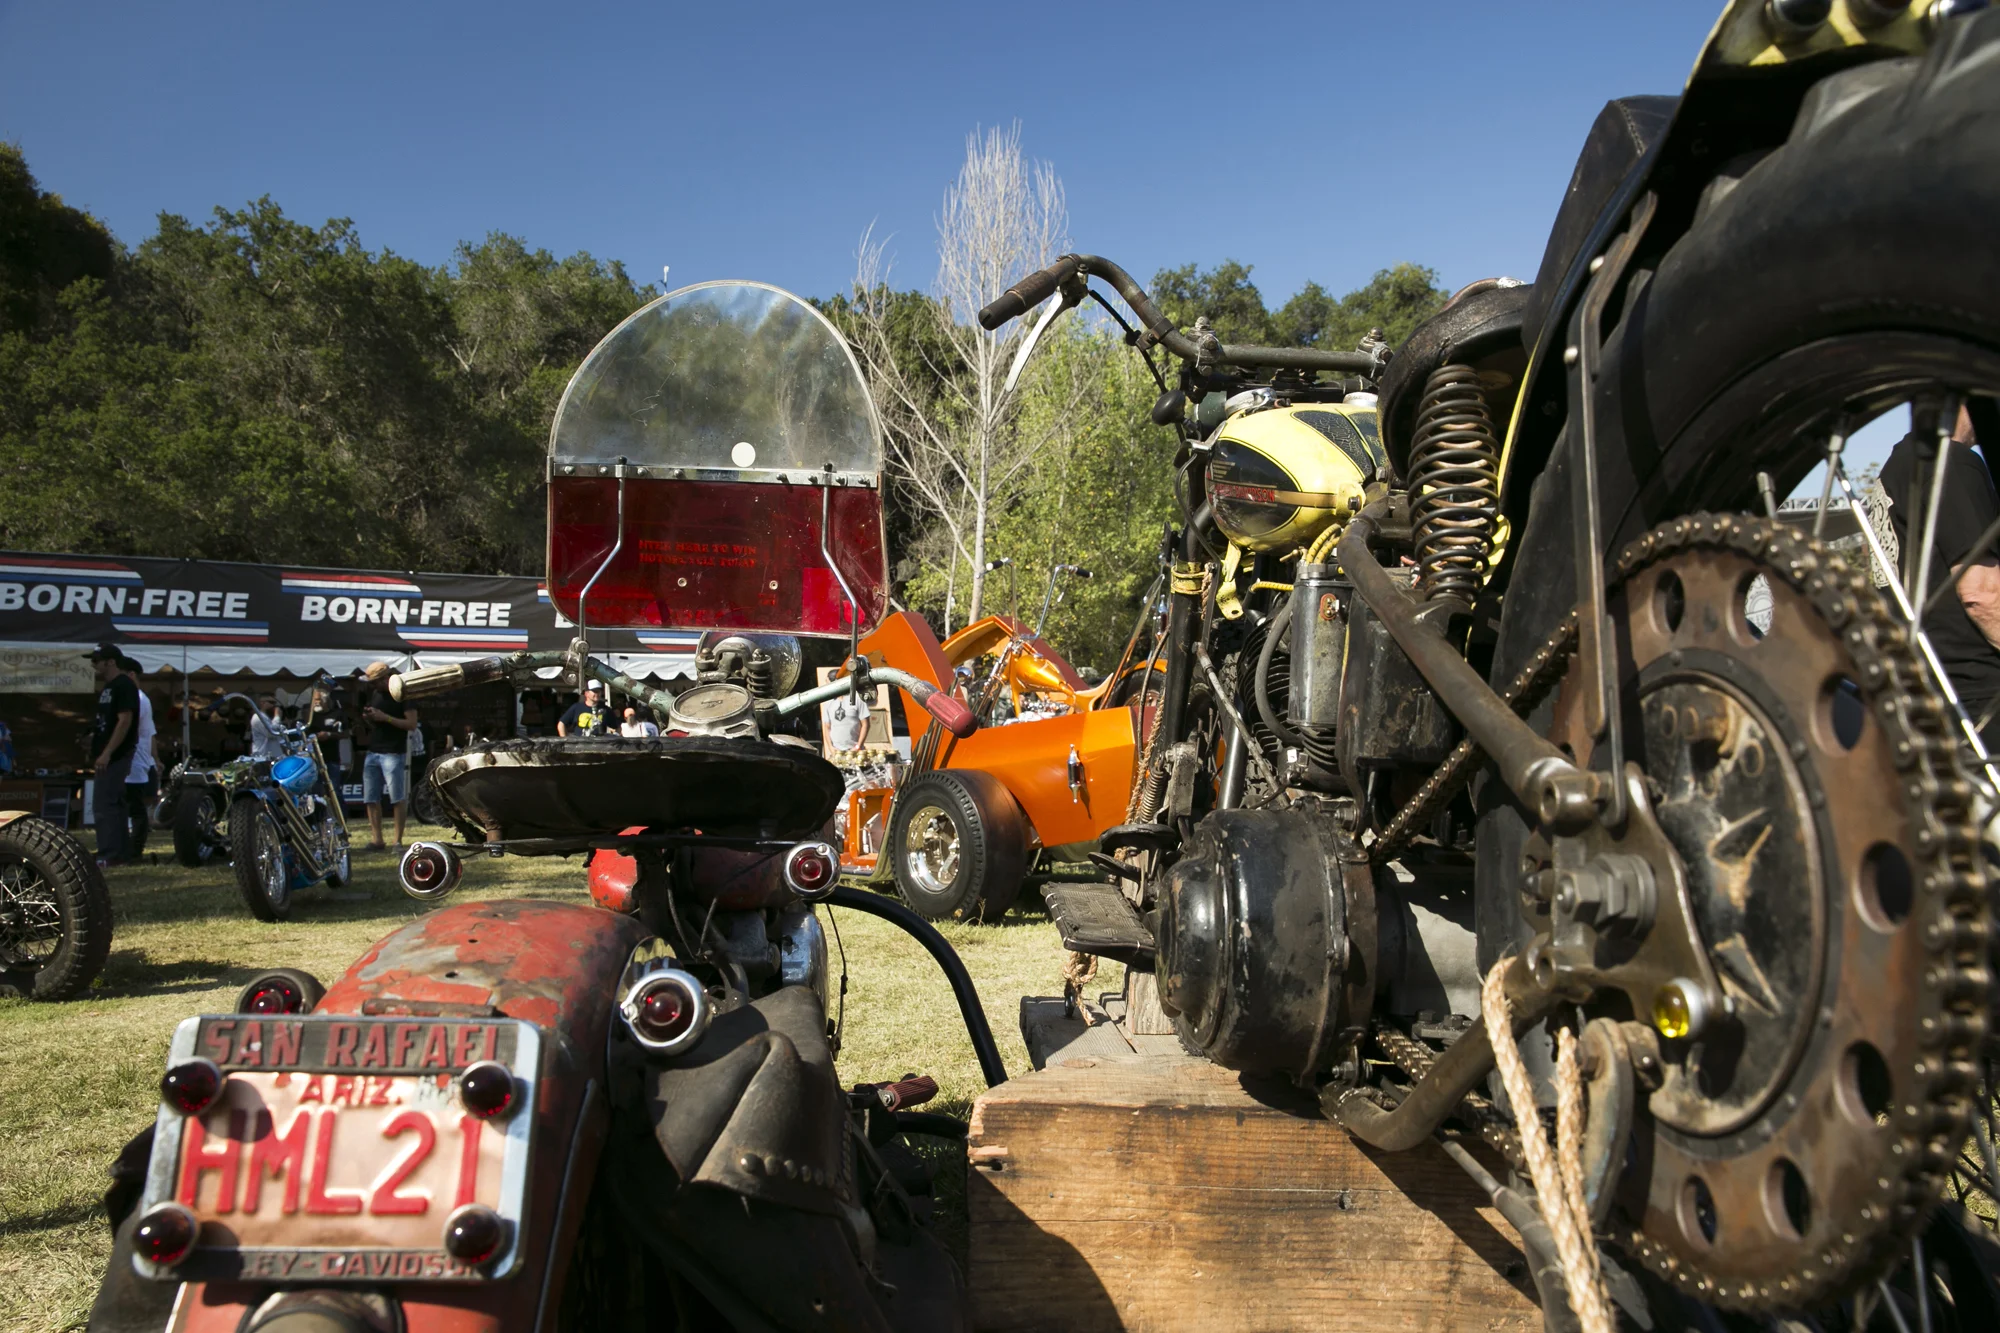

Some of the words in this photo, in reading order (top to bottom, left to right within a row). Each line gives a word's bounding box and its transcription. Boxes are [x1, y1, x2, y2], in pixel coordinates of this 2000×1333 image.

[731, 544, 757, 556] WIN
[0, 582, 250, 620] BORN-FREE
[301, 596, 512, 628] BORN-FREE
[26, 653, 93, 681] DESIGN
[205, 1020, 303, 1067] SAN
[177, 1107, 483, 1216] HML21
